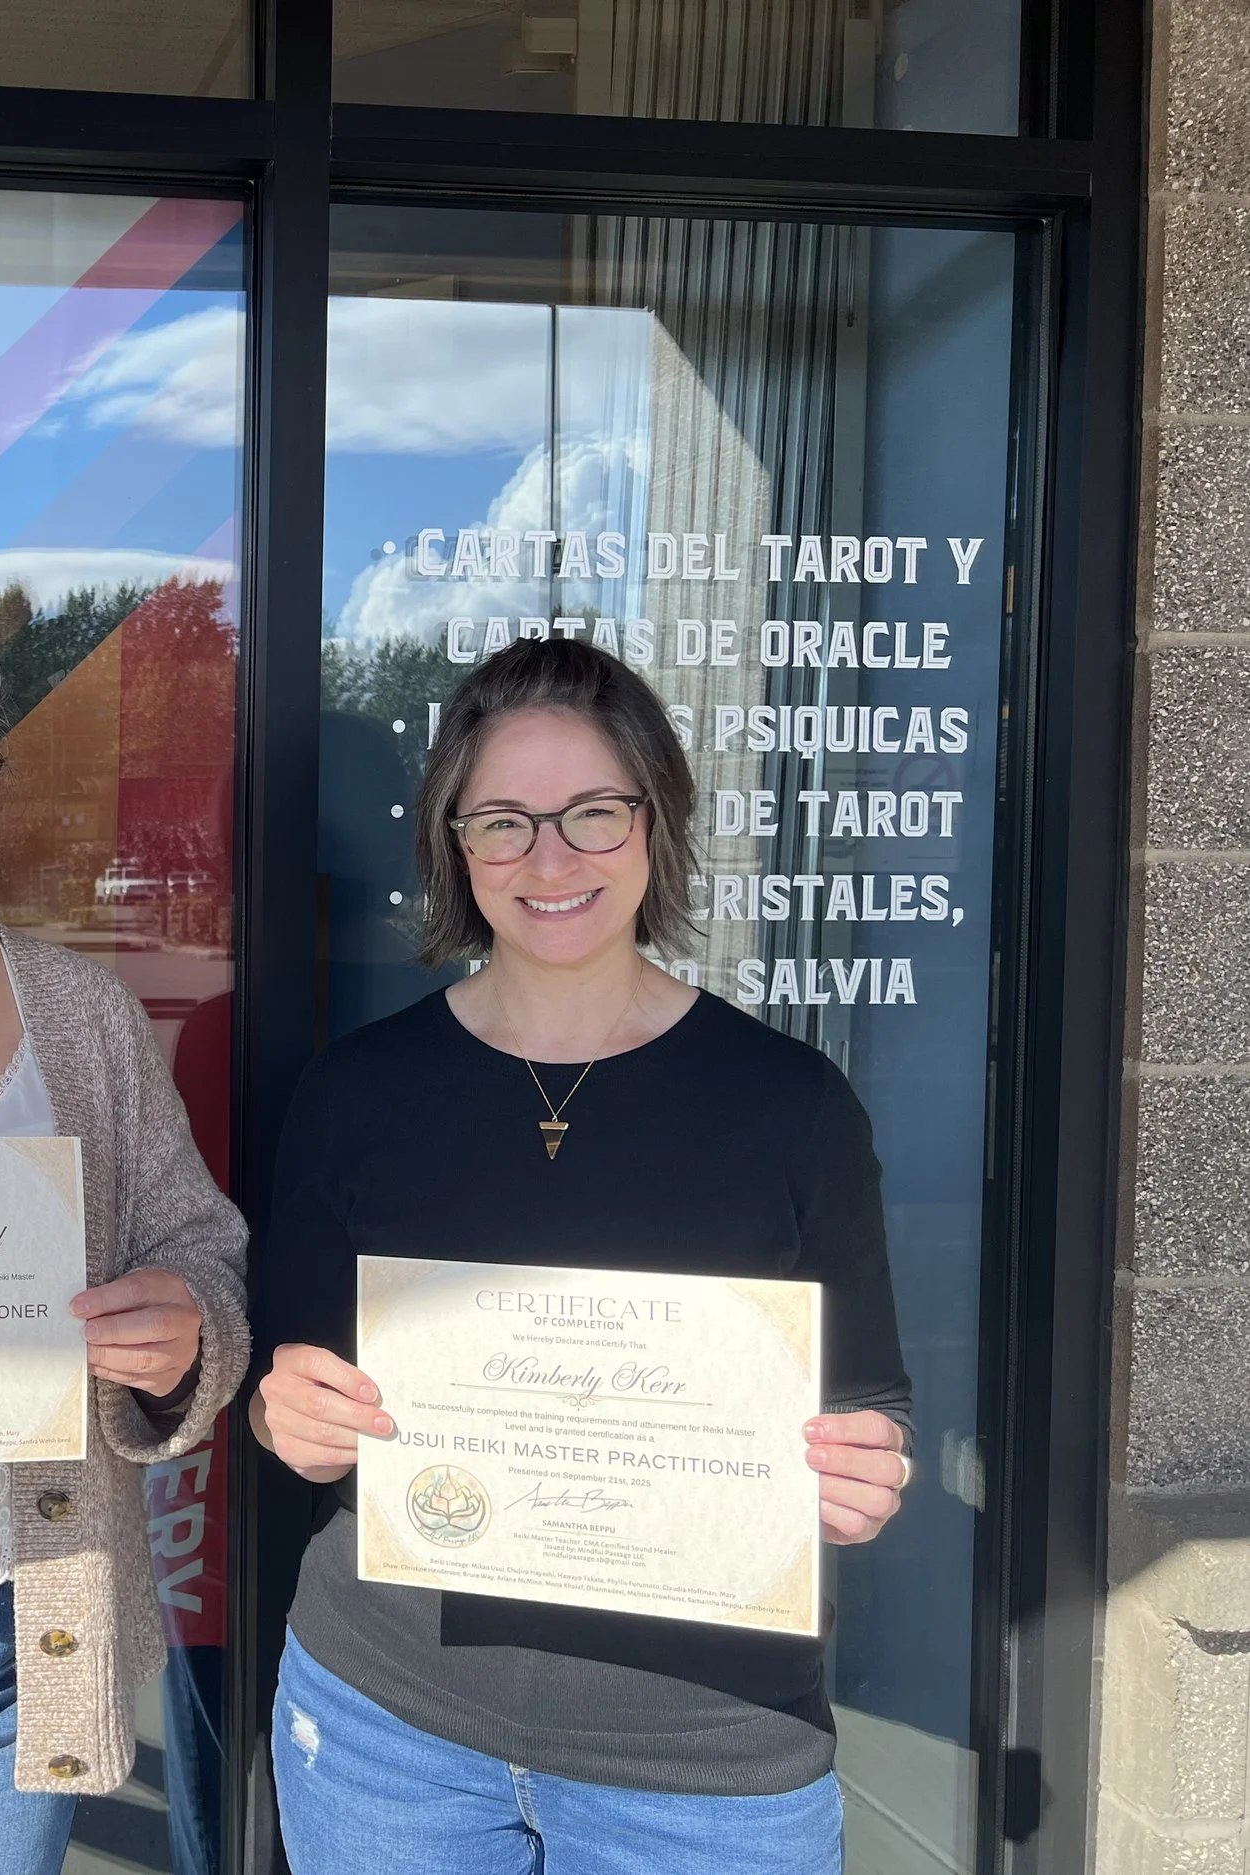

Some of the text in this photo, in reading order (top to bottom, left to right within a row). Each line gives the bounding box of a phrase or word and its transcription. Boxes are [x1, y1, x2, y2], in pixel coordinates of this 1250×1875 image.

[417, 528, 985, 585] CARTAS DEL TAROT Y
[675, 619, 740, 666] DE
[760, 620, 952, 669] ORACLE
[714, 705, 969, 759] PSIQUICAS
[714, 790, 963, 837] DE TAROT
[736, 958, 917, 1005] SALVIA
[476, 1290, 682, 1322] CERTIFICATE
[534, 1316, 624, 1330] OF COMPLETION
[483, 1352, 687, 1395] Kimberly Kerr
[411, 1401, 426, 1409] has
[427, 1404, 474, 1415] successfully
[476, 1408, 517, 1417] completed
[519, 1410, 532, 1418] the
[534, 1412, 564, 1423] training
[566, 1416, 620, 1425] requirements
[639, 1421, 686, 1431] attunement
[702, 1426, 723, 1434] Reiki
[726, 1428, 755, 1437] Master
[504, 1423, 526, 1431] Level
[554, 1428, 585, 1436] granted
[587, 1431, 634, 1440] certification
[399, 1431, 770, 1479] USUI REIKI MASTER PRACTITIONER
[508, 1466, 547, 1477] Presented
[563, 1472, 606, 1483] September
[631, 1478, 651, 1487] 2025
[542, 1520, 616, 1534] SAMANTHA BEPPU
